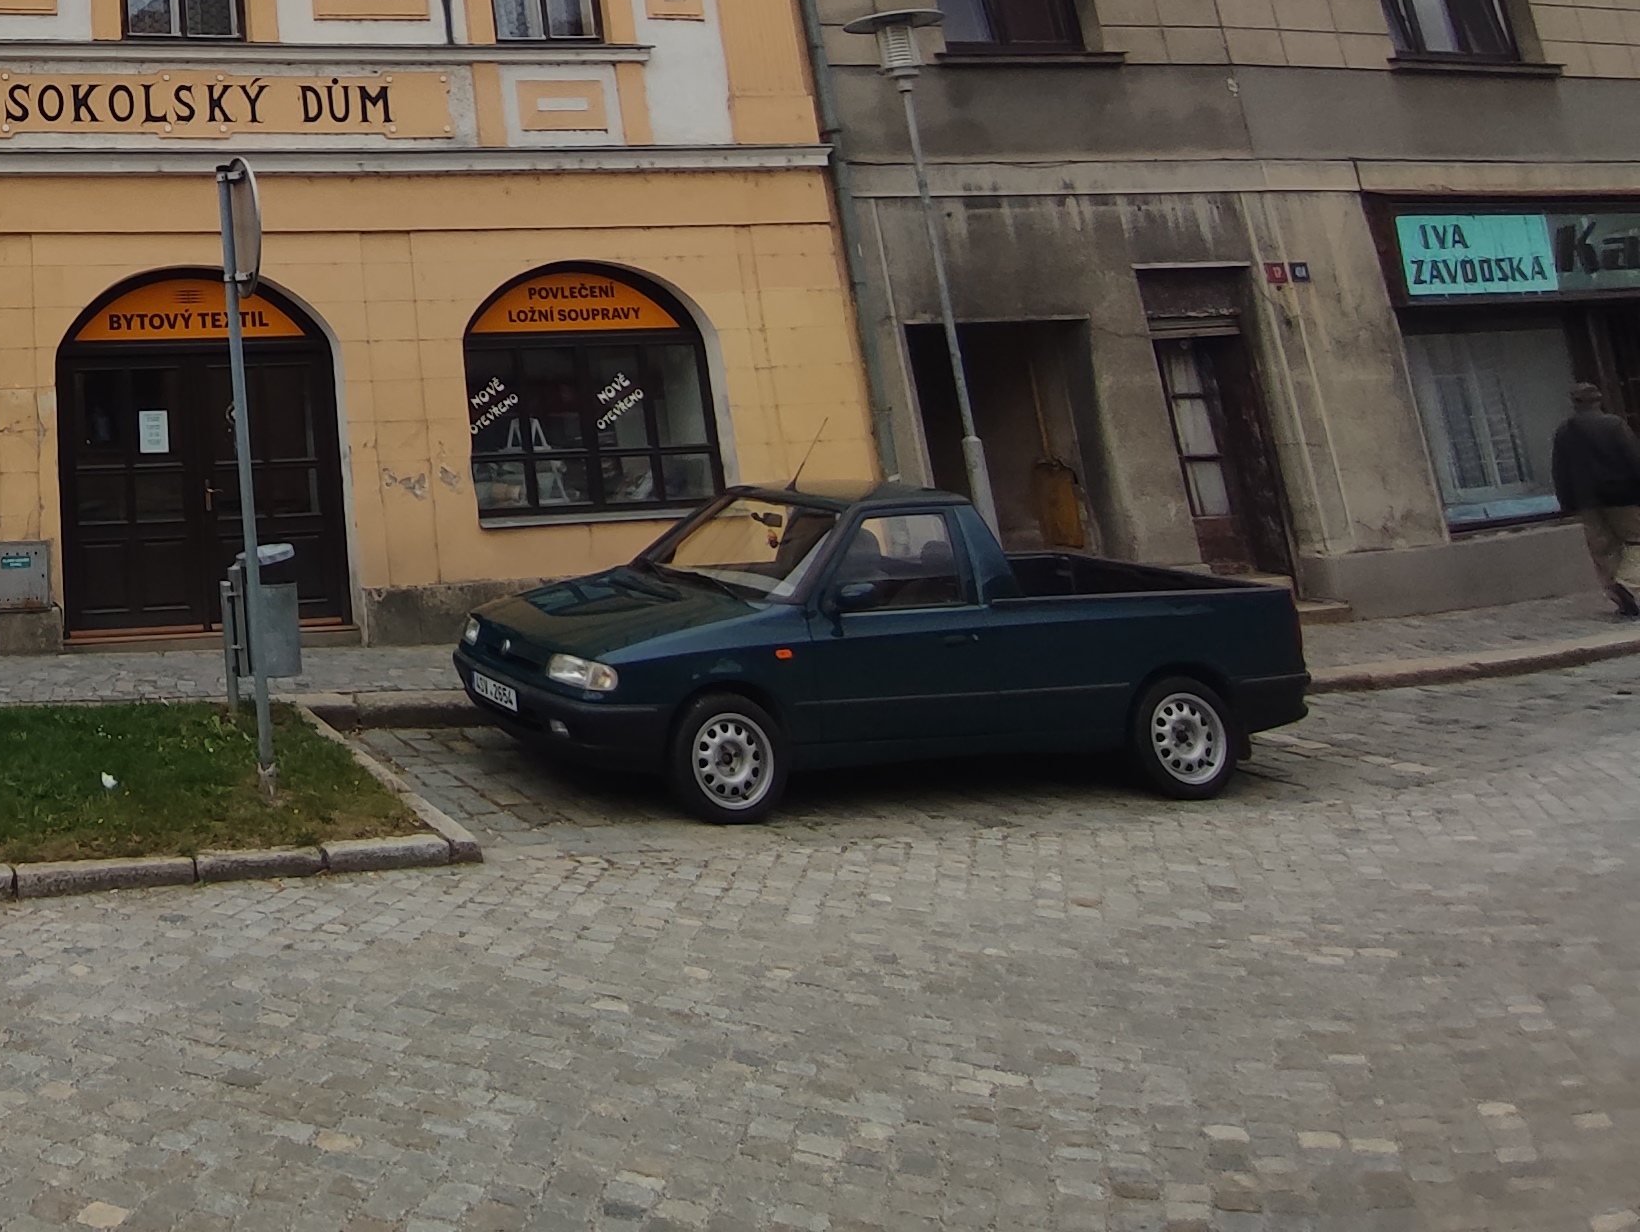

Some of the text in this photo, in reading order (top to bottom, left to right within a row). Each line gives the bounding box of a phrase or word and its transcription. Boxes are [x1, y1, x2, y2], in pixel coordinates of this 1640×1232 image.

[5, 77, 394, 125] SOKOLSKÝ DŮM
[1418, 224, 1470, 250] IVA
[528, 282, 615, 300] POVLEČENÍ
[109, 309, 193, 330] BYTOVÝ
[508, 306, 641, 323] LOŽNÍ SOUPRAVY
[470, 376, 505, 409] NOVĚ
[597, 372, 631, 405] NOVĚ
[596, 388, 644, 430] OTEVŘENO
